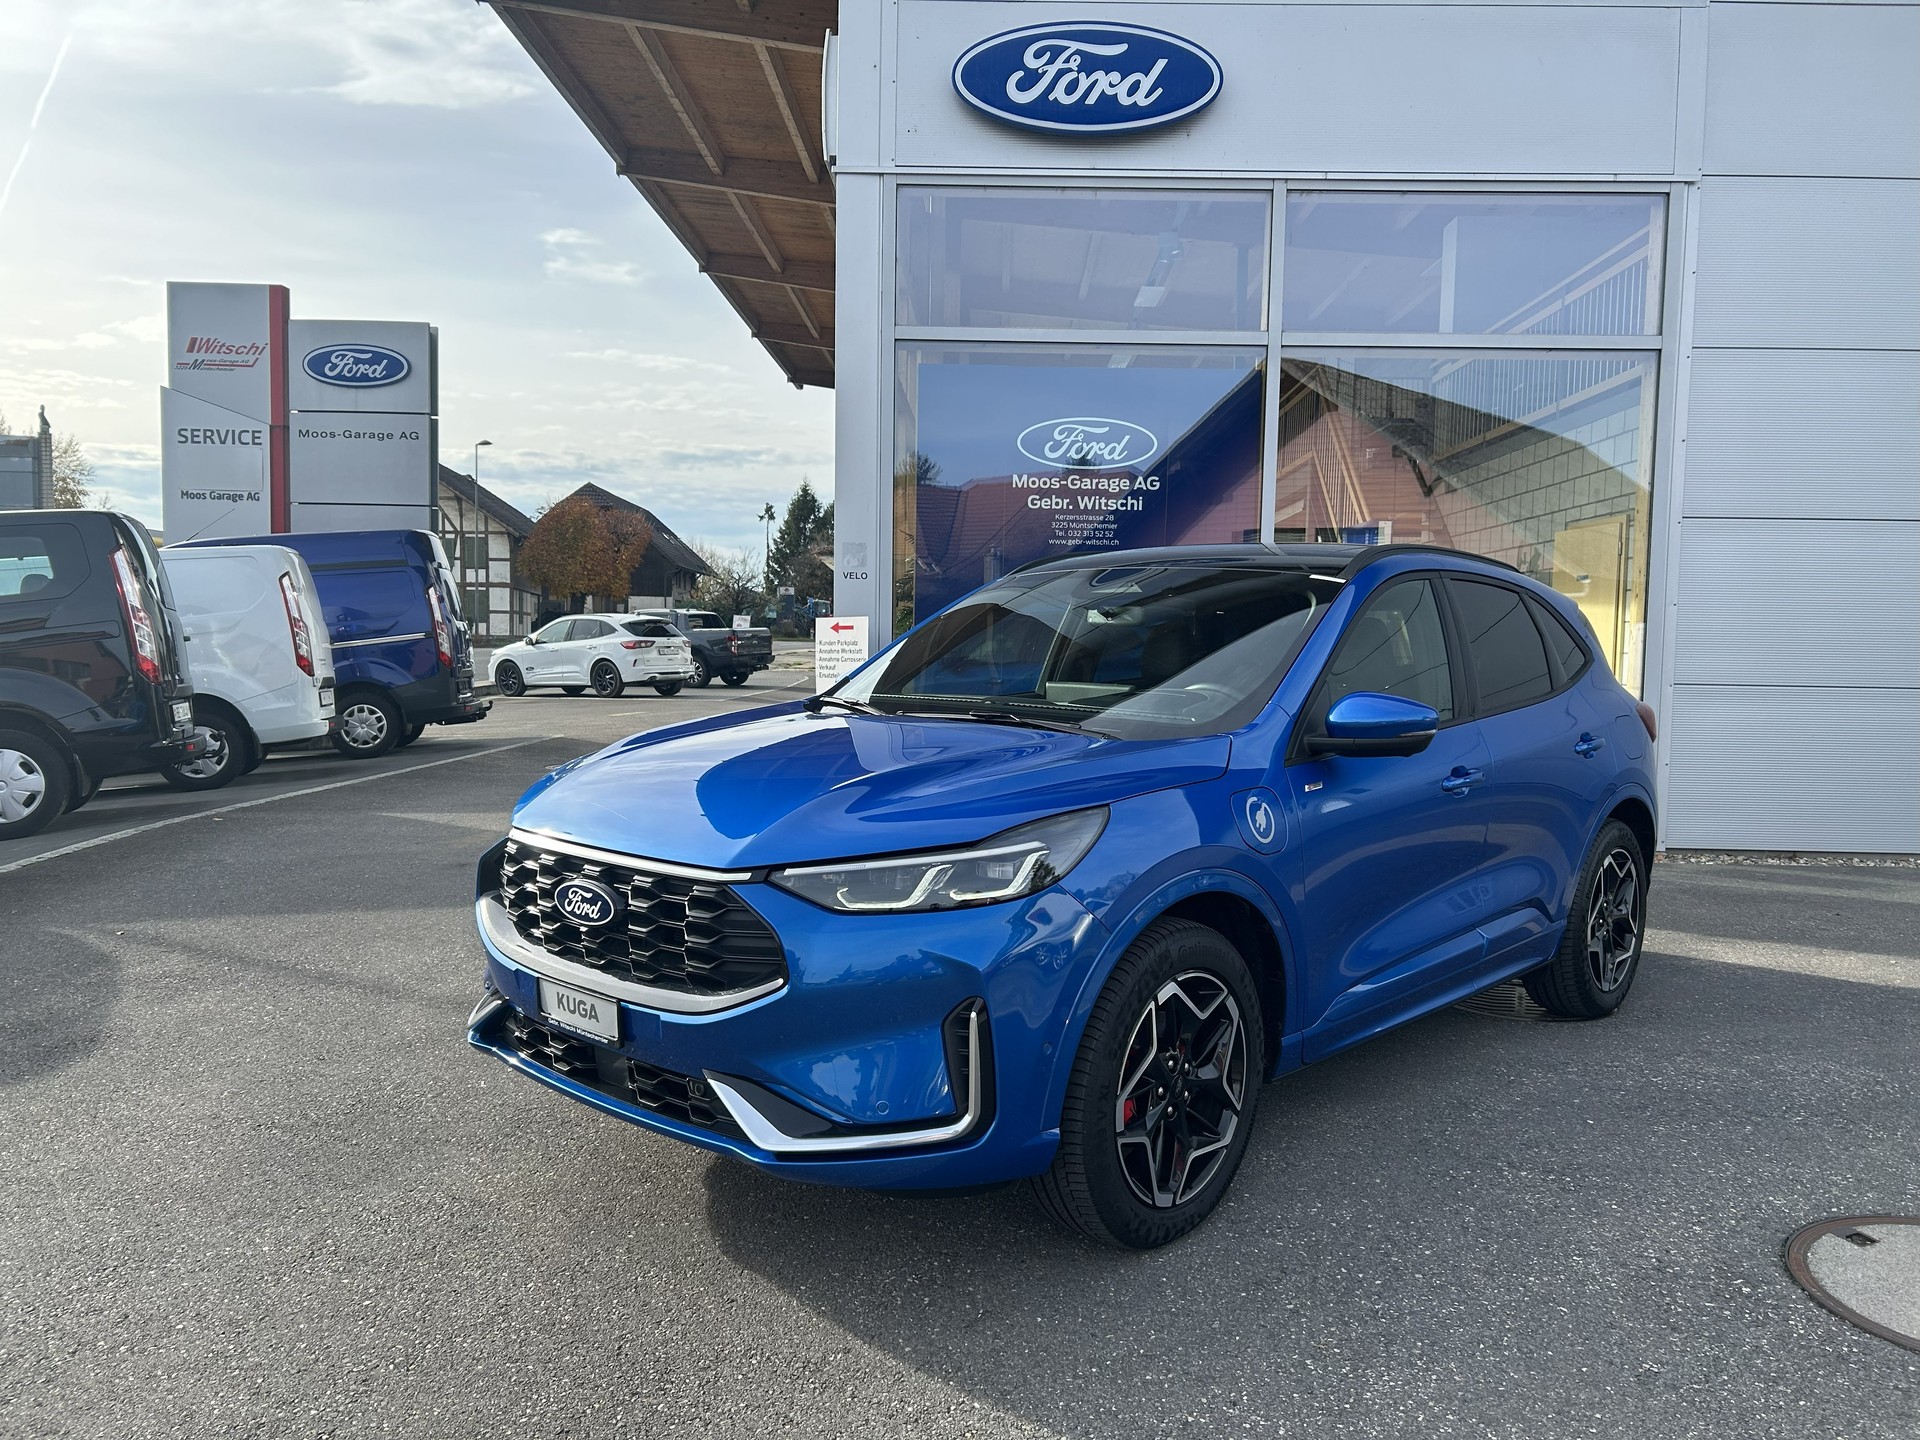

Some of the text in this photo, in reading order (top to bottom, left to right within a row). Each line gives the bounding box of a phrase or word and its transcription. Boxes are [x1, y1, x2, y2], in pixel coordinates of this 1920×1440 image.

[1005, 38, 1169, 107] Ford
[196, 337, 269, 356] Witschi
[324, 350, 387, 379] Ford
[177, 427, 263, 446] SERVICE
[298, 429, 420, 442] Moos-Garage AG
[1043, 424, 1131, 461] Ford
[1012, 474, 1160, 492] Moos-Garage AG
[180, 489, 260, 503] Moos Garage AG
[1027, 494, 1143, 511] Gebr. Witschi
[842, 571, 868, 580] VELO
[564, 887, 602, 920] Ford
[556, 991, 600, 1024] KUGA
